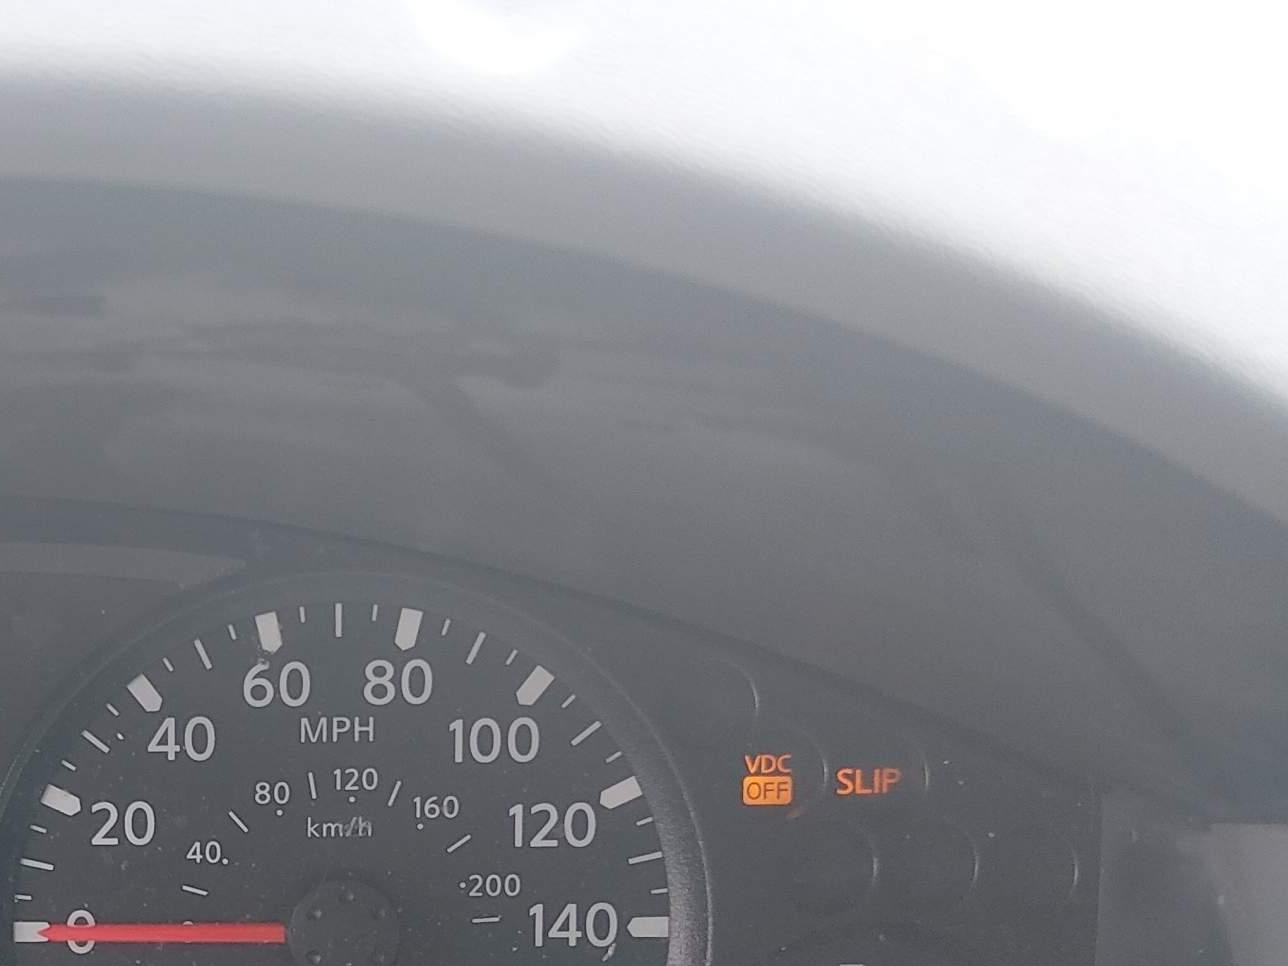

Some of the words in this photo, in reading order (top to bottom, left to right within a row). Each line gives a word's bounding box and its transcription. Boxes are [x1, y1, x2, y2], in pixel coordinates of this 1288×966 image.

[243, 661, 310, 707] 60
[363, 659, 432, 705] 80
[147, 716, 216, 761] 40
[300, 717, 374, 742] MPH
[449, 717, 540, 763] 100
[744, 755, 792, 774] VDC
[333, 767, 379, 791] 120
[746, 781, 789, 800] OFF
[836, 767, 902, 795] SLIP
[254, 781, 290, 804] 80
[413, 795, 459, 819] 160
[91, 800, 155, 846] 20
[307, 816, 372, 838] km/h
[509, 802, 596, 848] 120
[186, 840, 221, 864] 40
[468, 873, 521, 897] 200
[66, 909, 96, 954] 0
[529, 902, 617, 948] 140
